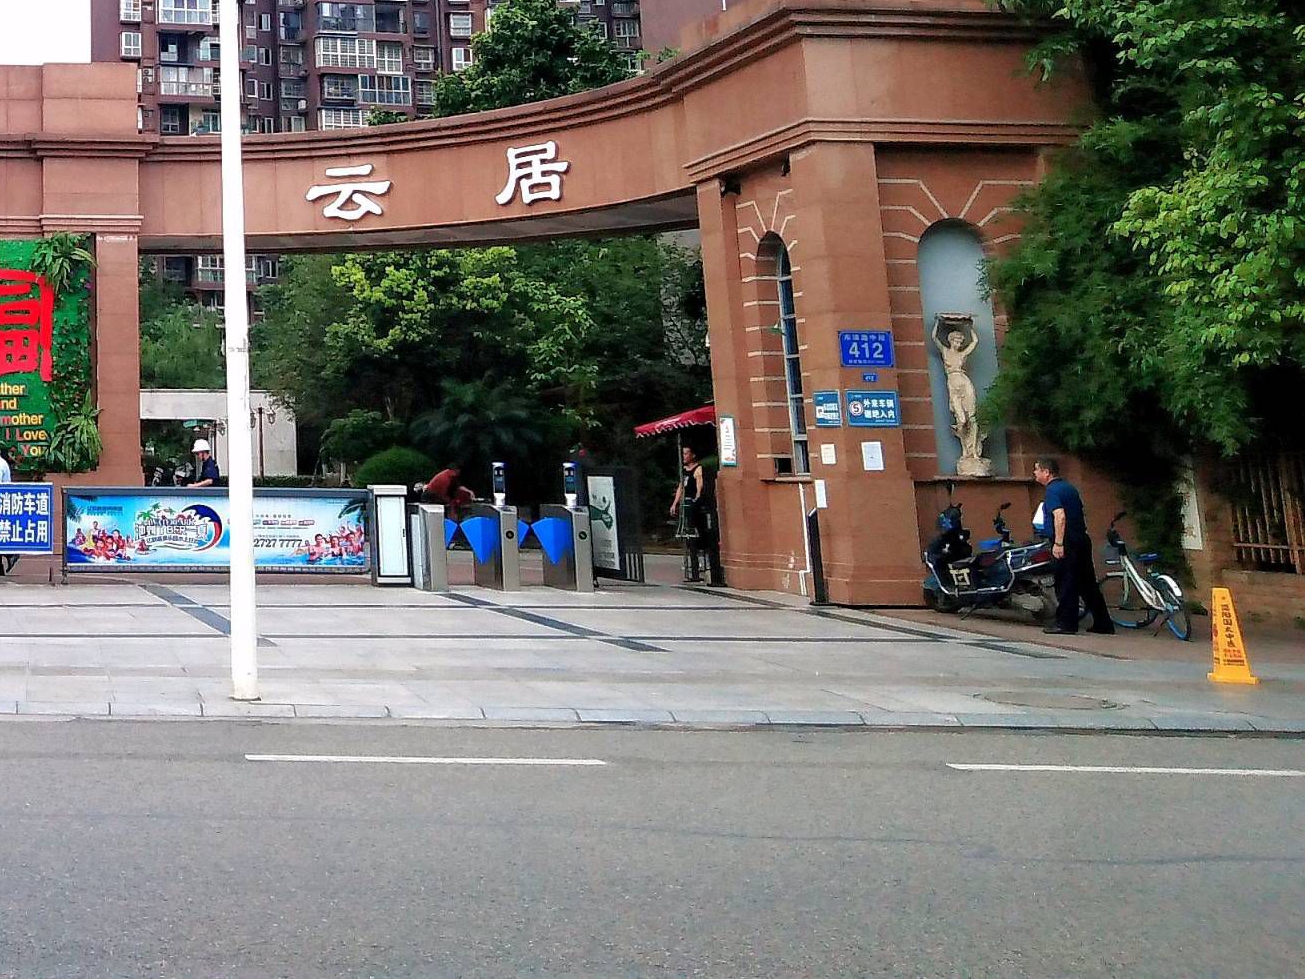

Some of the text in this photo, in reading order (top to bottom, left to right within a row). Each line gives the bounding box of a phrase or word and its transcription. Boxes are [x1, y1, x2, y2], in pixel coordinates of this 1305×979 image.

[848, 341, 885, 359] 412
[863, 398, 895, 409] 外来车辆
[0, 413, 44, 426] mother
[15, 428, 48, 441] Love
[253, 538, 277, 548] 2727
